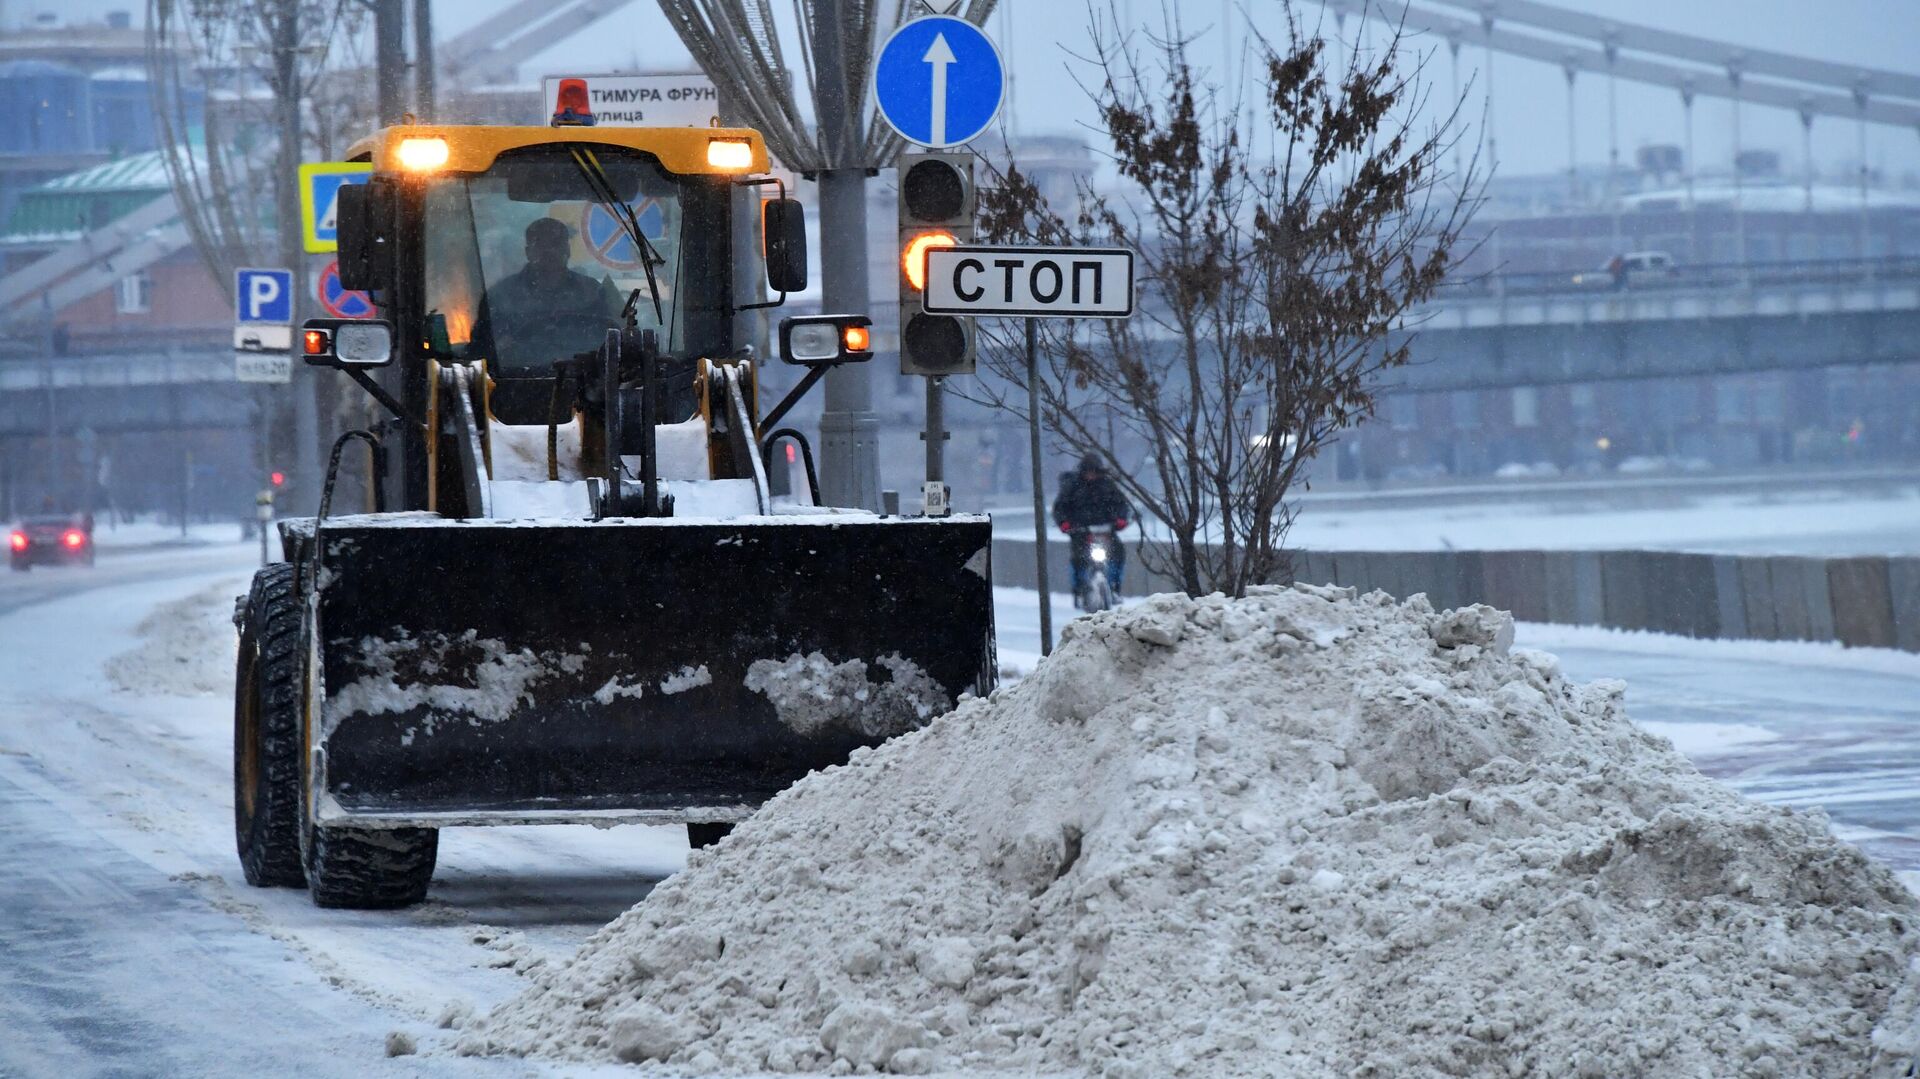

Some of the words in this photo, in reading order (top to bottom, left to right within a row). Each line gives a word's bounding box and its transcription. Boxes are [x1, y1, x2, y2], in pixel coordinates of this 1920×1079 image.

[591, 88, 662, 103] ТИМУРА
[667, 87, 717, 101] ФРУН
[592, 111, 643, 123] улица
[953, 258, 1103, 304] СТОП
[250, 275, 279, 318] P
